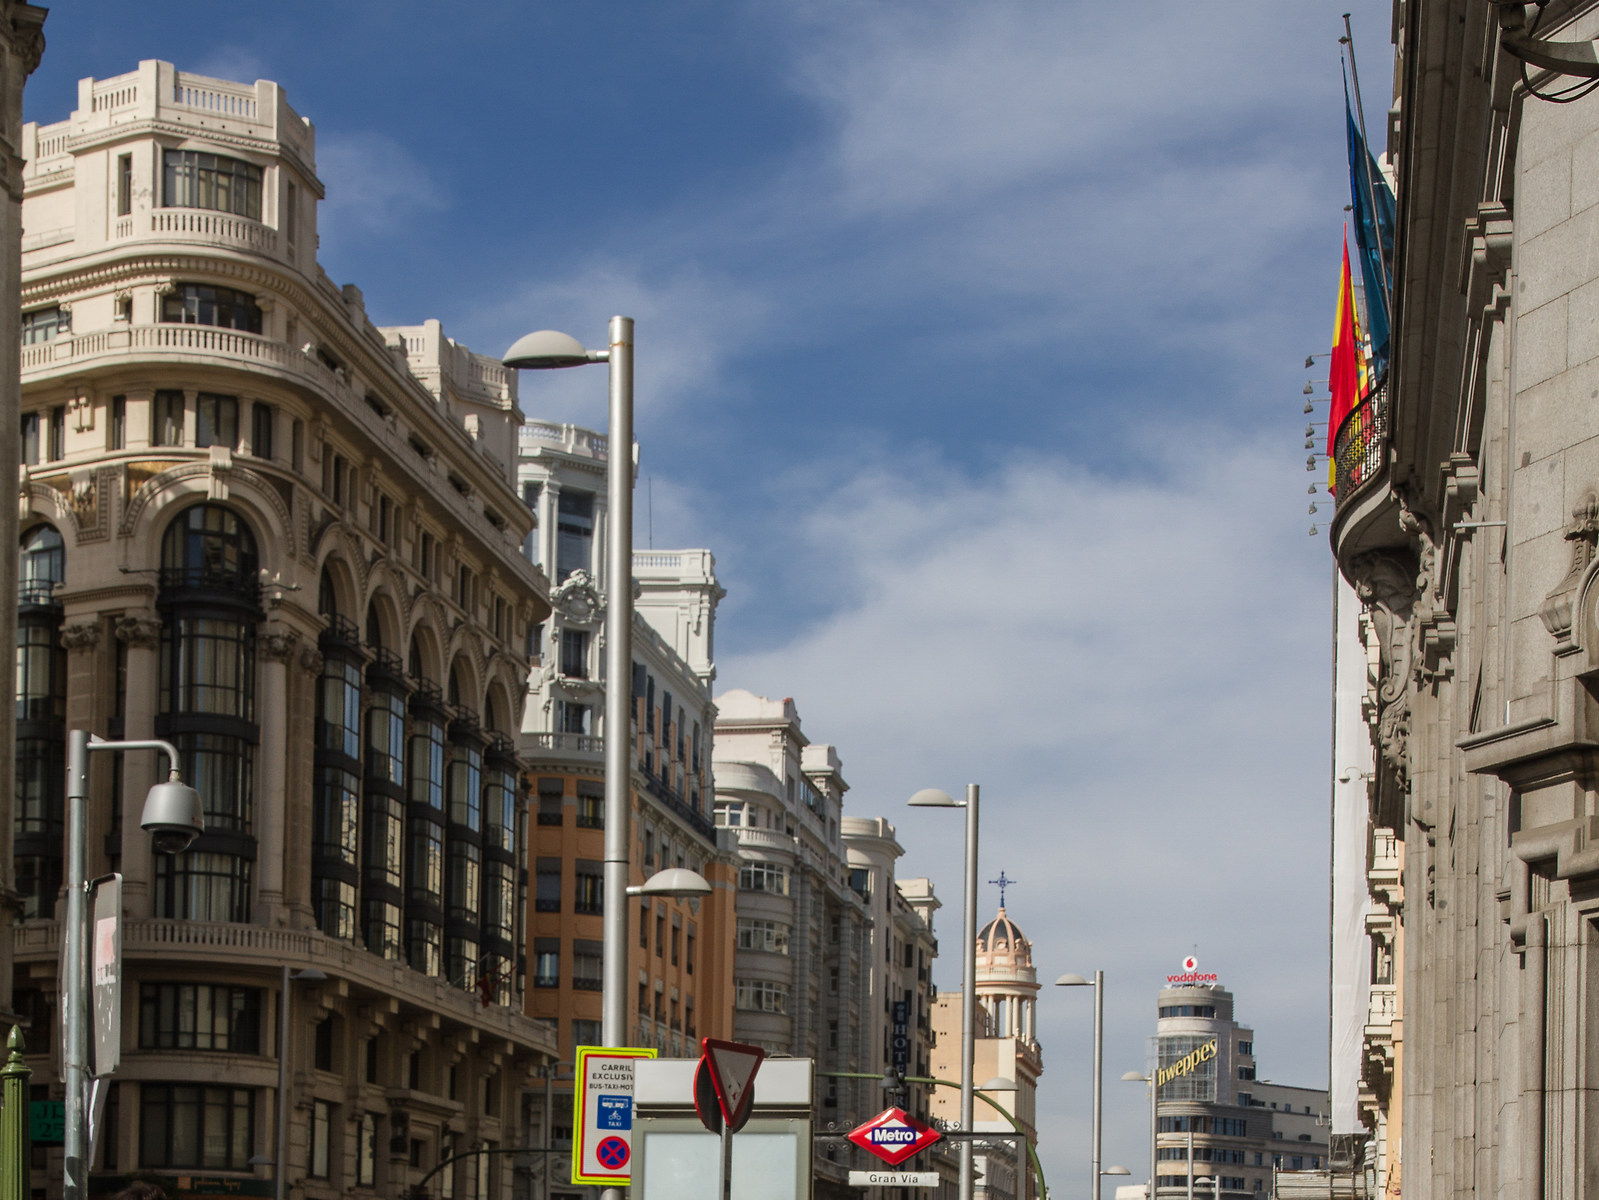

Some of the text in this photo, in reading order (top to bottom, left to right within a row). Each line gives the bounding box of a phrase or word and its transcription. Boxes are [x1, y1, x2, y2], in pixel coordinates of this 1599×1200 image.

[1167, 971, 1217, 983] vodafone
[894, 1024, 906, 1075] HOTE
[1156, 1038, 1217, 1088] hweppes
[874, 1129, 914, 1141] Metro
[869, 1174, 897, 1183] Gran
